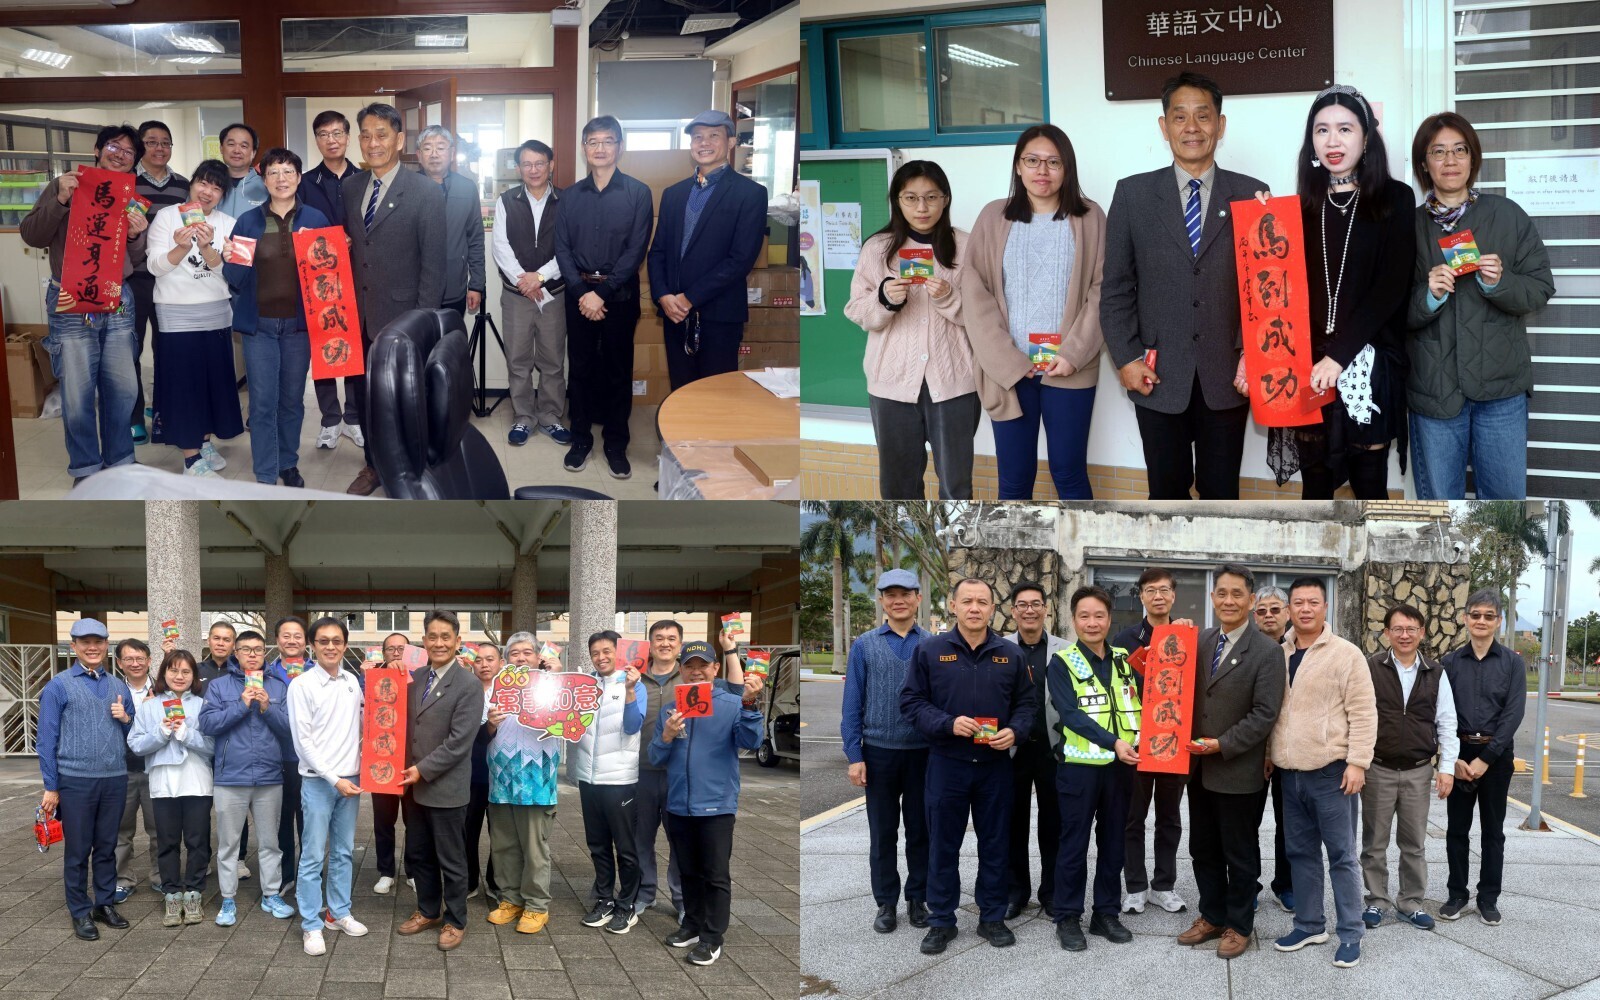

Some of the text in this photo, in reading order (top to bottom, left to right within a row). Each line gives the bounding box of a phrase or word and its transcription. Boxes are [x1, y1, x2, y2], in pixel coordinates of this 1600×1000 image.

[1128, 46, 1307, 68] Chinese Language Center
[1146, 3, 1283, 38] 華語文中心
[76, 180, 116, 307] 馬運亨通
[310, 235, 350, 366] 馬到成功
[1252, 212, 1298, 406] 馬到成功
[681, 685, 709, 716] 馬
[686, 645, 707, 653] NDHU
[1148, 633, 1187, 757] 馬到成功
[369, 677, 398, 781] 馬到成功
